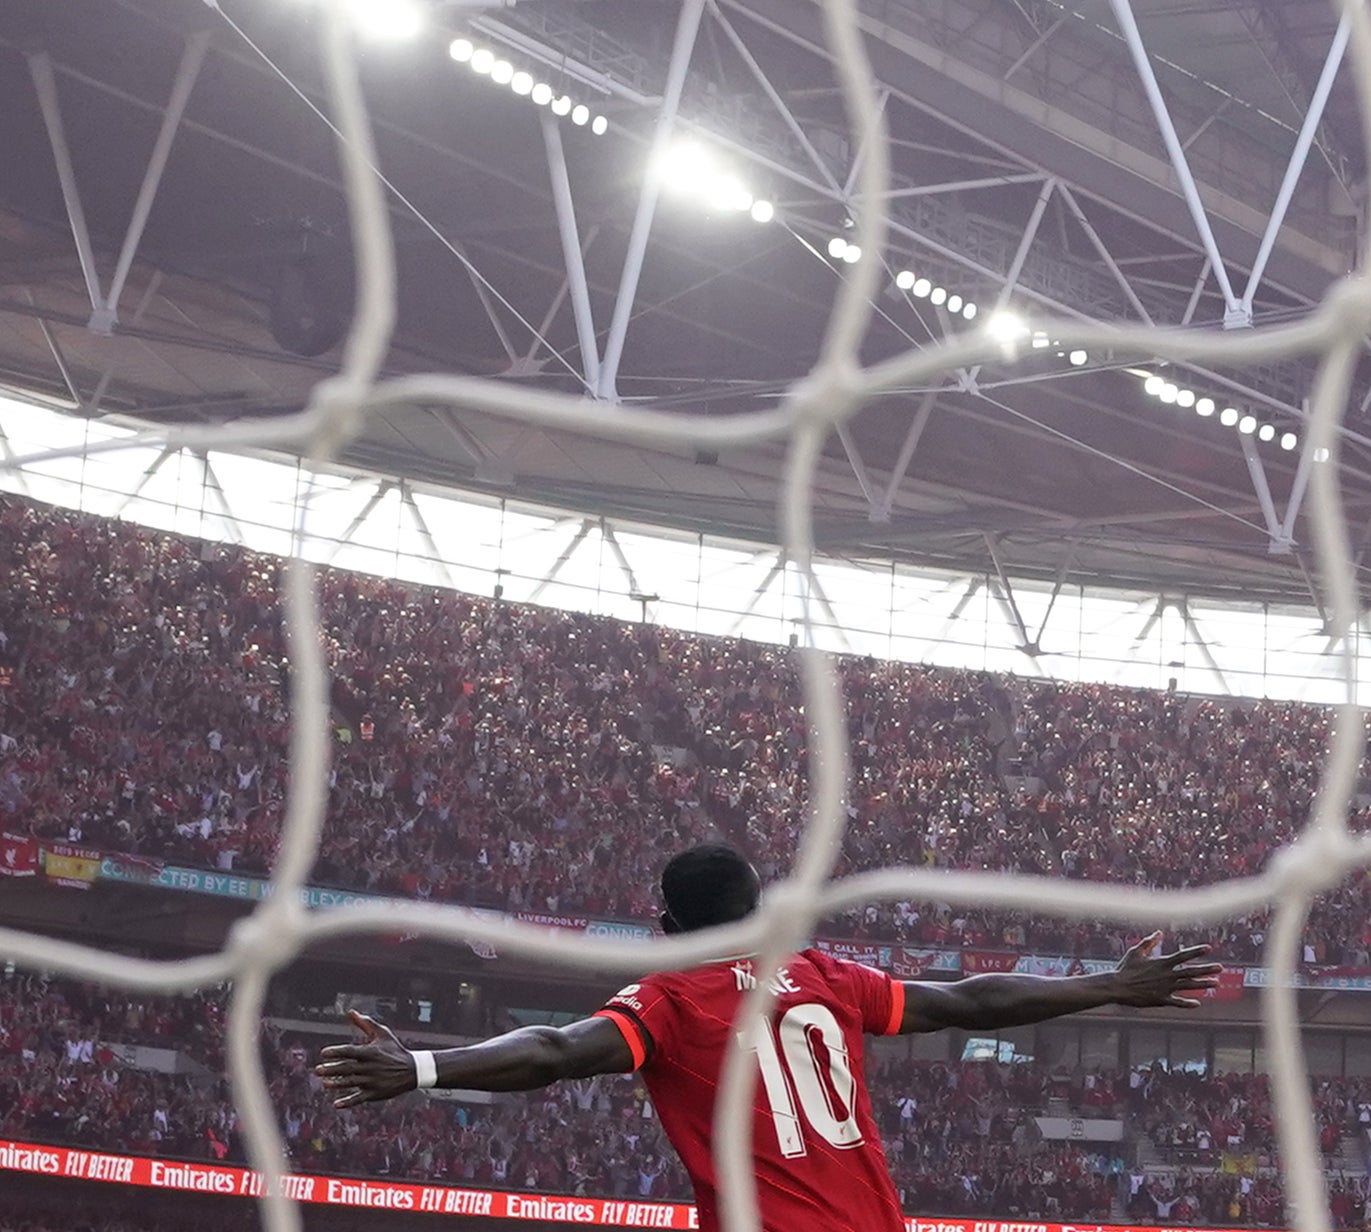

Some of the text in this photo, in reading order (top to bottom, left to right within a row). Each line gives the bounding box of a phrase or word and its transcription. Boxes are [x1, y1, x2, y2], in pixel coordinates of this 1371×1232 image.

[204, 876, 226, 891] BY
[229, 881, 247, 895] EE
[261, 883, 342, 907] WBLEY
[736, 1003, 865, 1159] 10
[0, 1144, 133, 1181] mirates FLY BETTER
[151, 1162, 234, 1192] Emirates
[327, 1180, 492, 1215] Emirates FLY BETTER
[506, 1195, 595, 1222] Emirates
[602, 1202, 624, 1224] FLY
[626, 1204, 673, 1227] BETTER
